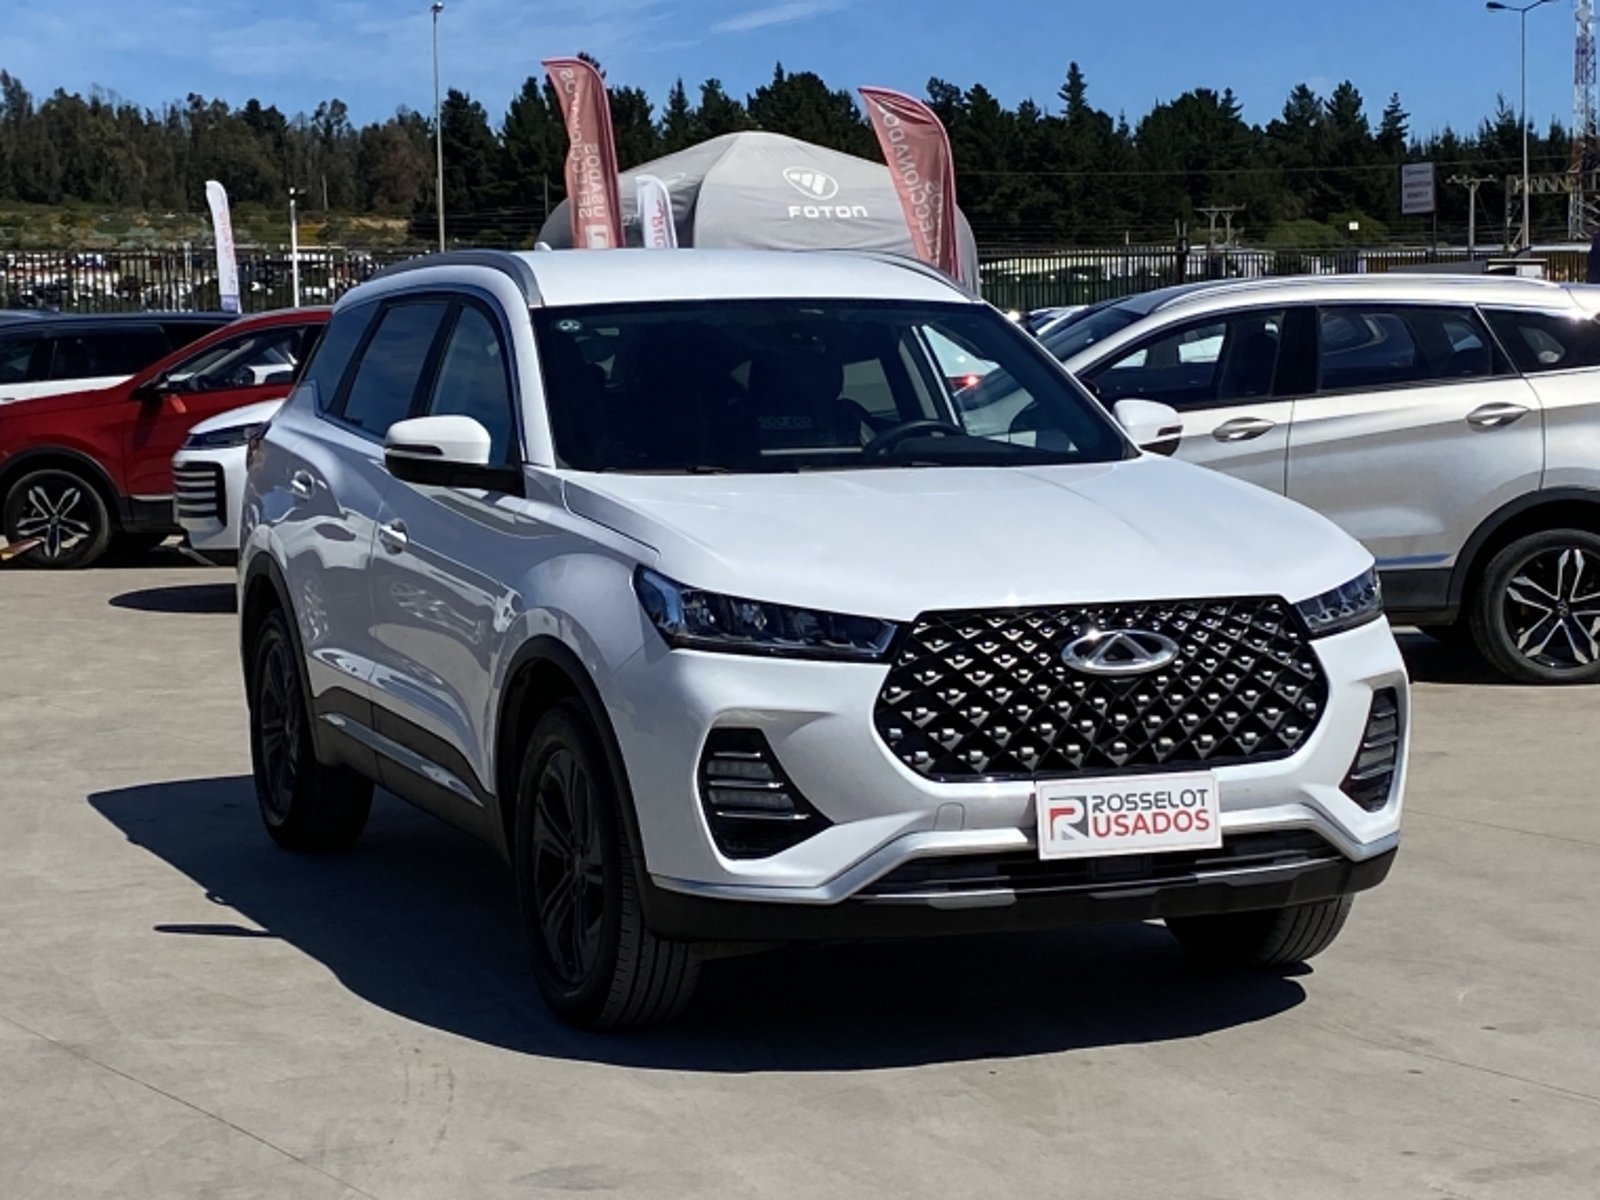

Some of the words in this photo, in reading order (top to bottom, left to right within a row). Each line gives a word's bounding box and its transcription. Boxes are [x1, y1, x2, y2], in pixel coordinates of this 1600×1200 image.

[788, 206, 868, 218] FOTON
[1091, 789, 1208, 813] ROSSELOT
[1092, 809, 1210, 838] USADOS
